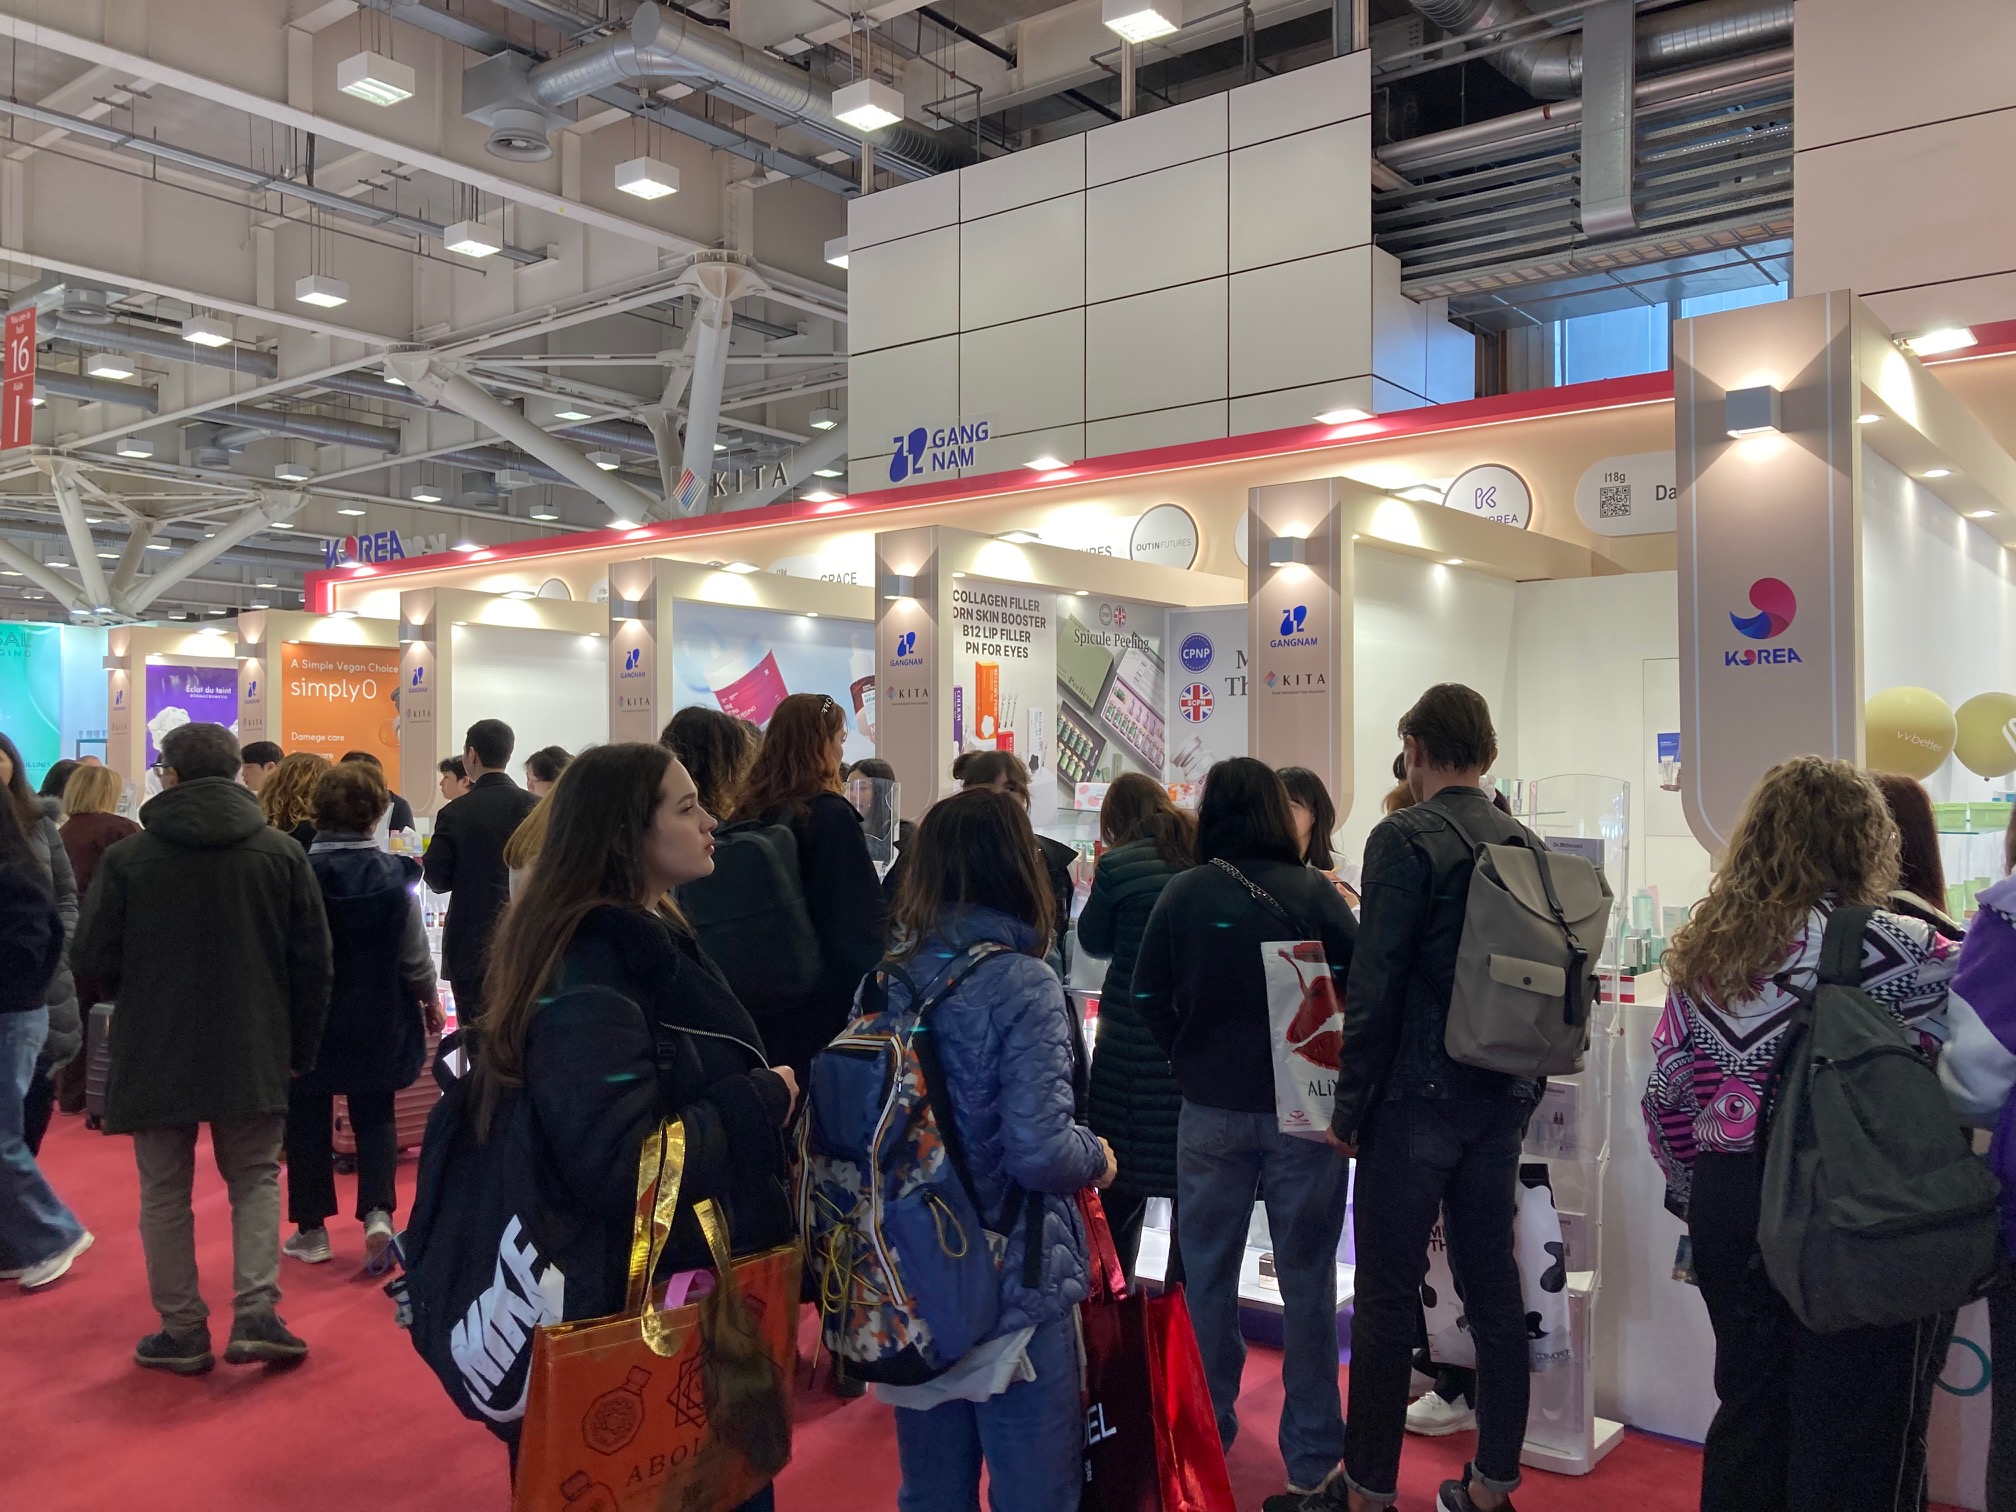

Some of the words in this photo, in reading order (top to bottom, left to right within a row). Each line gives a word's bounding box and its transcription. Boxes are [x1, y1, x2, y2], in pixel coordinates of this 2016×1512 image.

[11, 336, 29, 374] 16
[932, 421, 990, 449] GANG
[932, 447, 977, 473] NAM
[712, 461, 789, 498] KITA
[326, 530, 406, 570] KOREA
[953, 590, 1008, 608] COLLAGEN
[1010, 596, 1040, 612] FILLER
[976, 610, 999, 624] SKIN
[1002, 612, 1046, 629] BOOSTER
[962, 624, 981, 638] B12
[983, 626, 998, 640] LIP
[1000, 628, 1031, 643] FILLER
[1074, 628, 1112, 647] Spicule
[1114, 633, 1150, 653] Peeling
[966, 642, 980, 654] PN
[982, 643, 1002, 657] FOR
[1004, 645, 1029, 659] EYES
[1270, 637, 1318, 648] GANGNAM
[1182, 648, 1210, 659] CPNP
[1725, 647, 1802, 666] KOREA
[290, 659, 299, 668] A
[302, 659, 334, 672] Simple
[336, 662, 366, 674] Vegan
[368, 663, 399, 674] Choice
[889, 657, 924, 668] GANGNAM
[620, 671, 646, 679] GANGNAM
[1283, 674, 1326, 686] KITA
[205, 686, 214, 694] du
[899, 688, 929, 698] KITA
[627, 697, 650, 706] KITA
[413, 710, 431, 718] KITA
